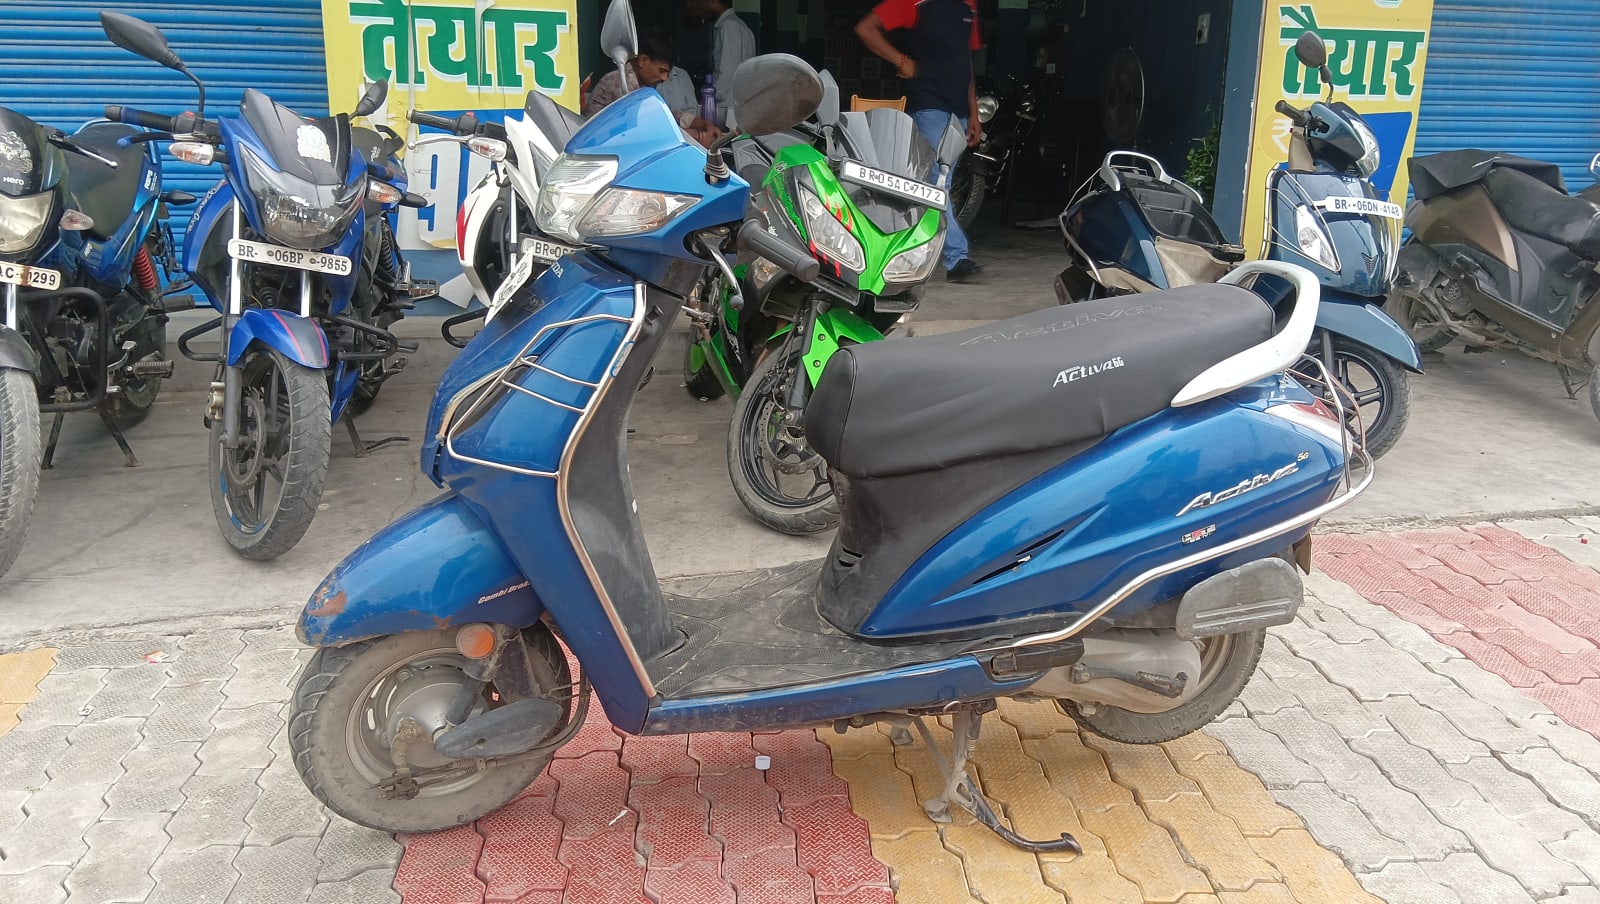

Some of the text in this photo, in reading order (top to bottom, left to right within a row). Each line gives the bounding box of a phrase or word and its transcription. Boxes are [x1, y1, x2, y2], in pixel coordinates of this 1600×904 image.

[3, 176, 25, 186] Hero
[1052, 359, 1114, 388] Activa
[1175, 451, 1310, 517] Activa 5G
